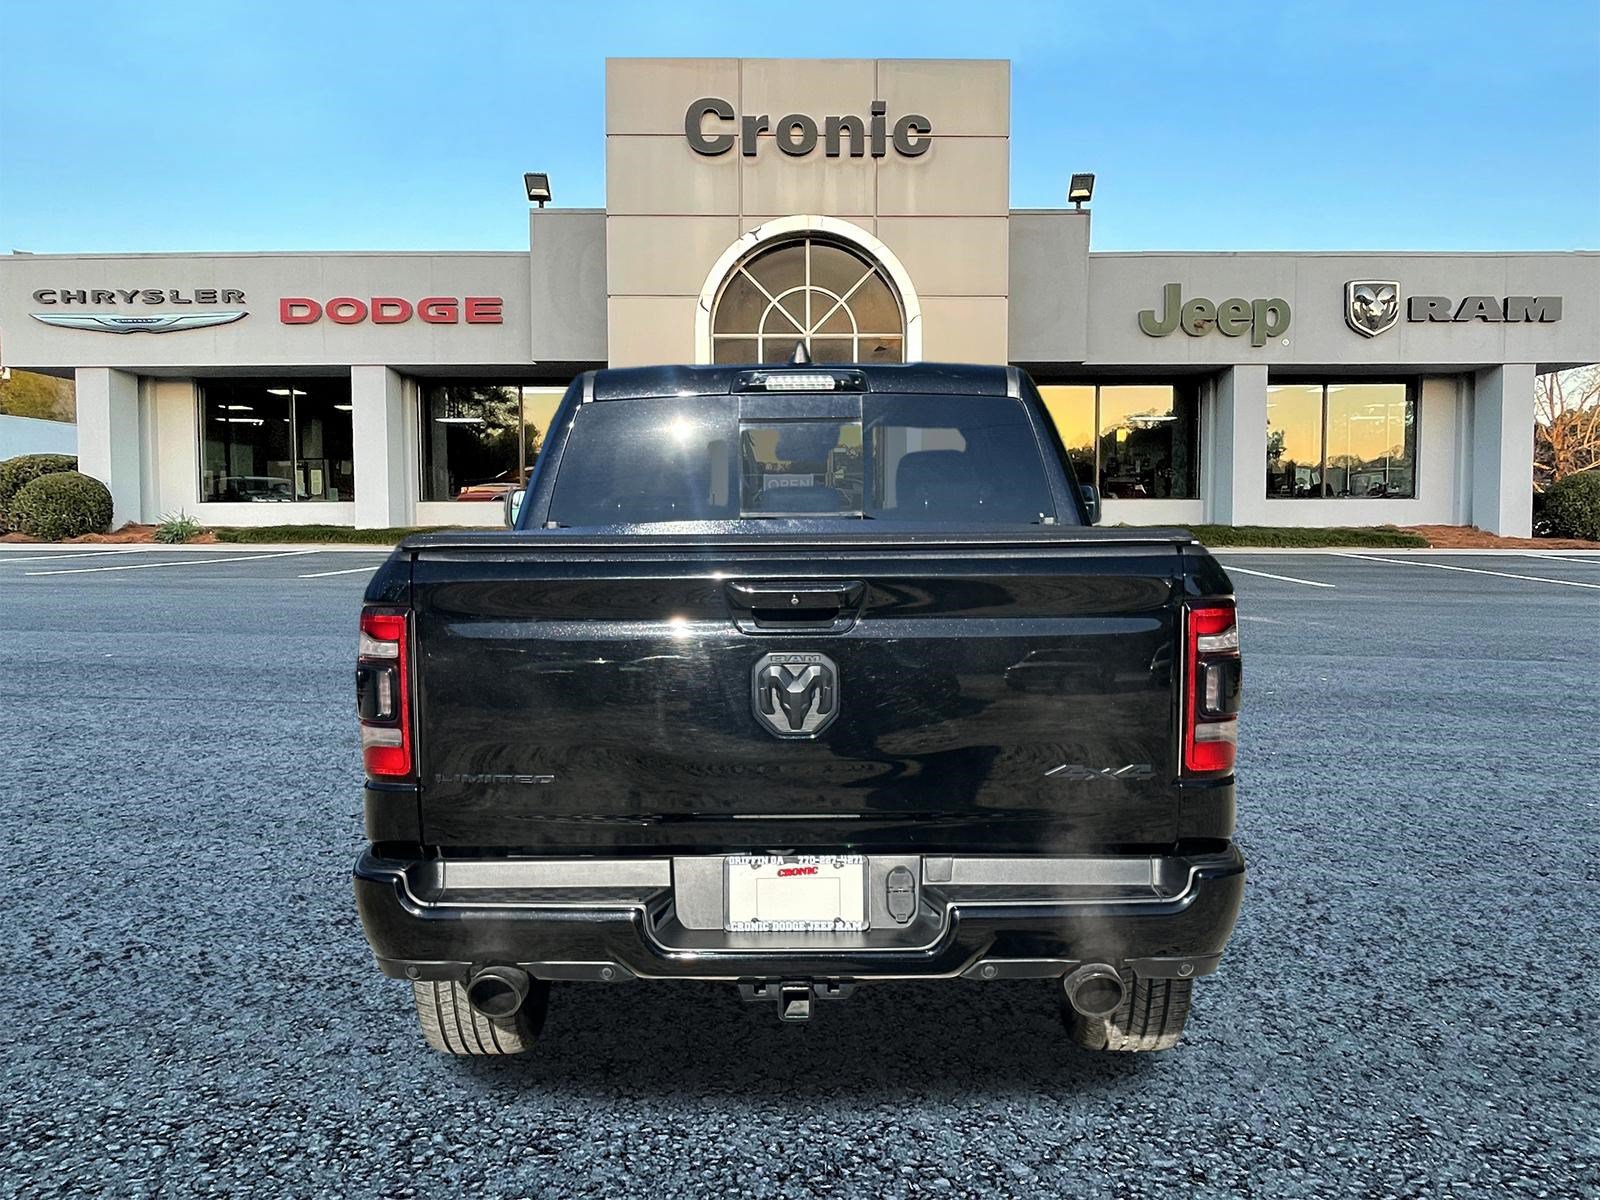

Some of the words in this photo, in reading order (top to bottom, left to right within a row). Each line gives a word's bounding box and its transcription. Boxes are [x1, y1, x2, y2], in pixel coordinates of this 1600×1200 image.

[685, 97, 932, 157] Cronic
[32, 289, 246, 304] CHRYSLER
[279, 297, 503, 324] DODGE
[1138, 283, 1291, 347] Jeep
[1407, 296, 1562, 322] RAM
[770, 655, 820, 663] RAM
[435, 774, 554, 783] LIMITED
[777, 866, 819, 877] CRONIC
[731, 921, 770, 931] CRONIC
[772, 921, 806, 931] DODGE
